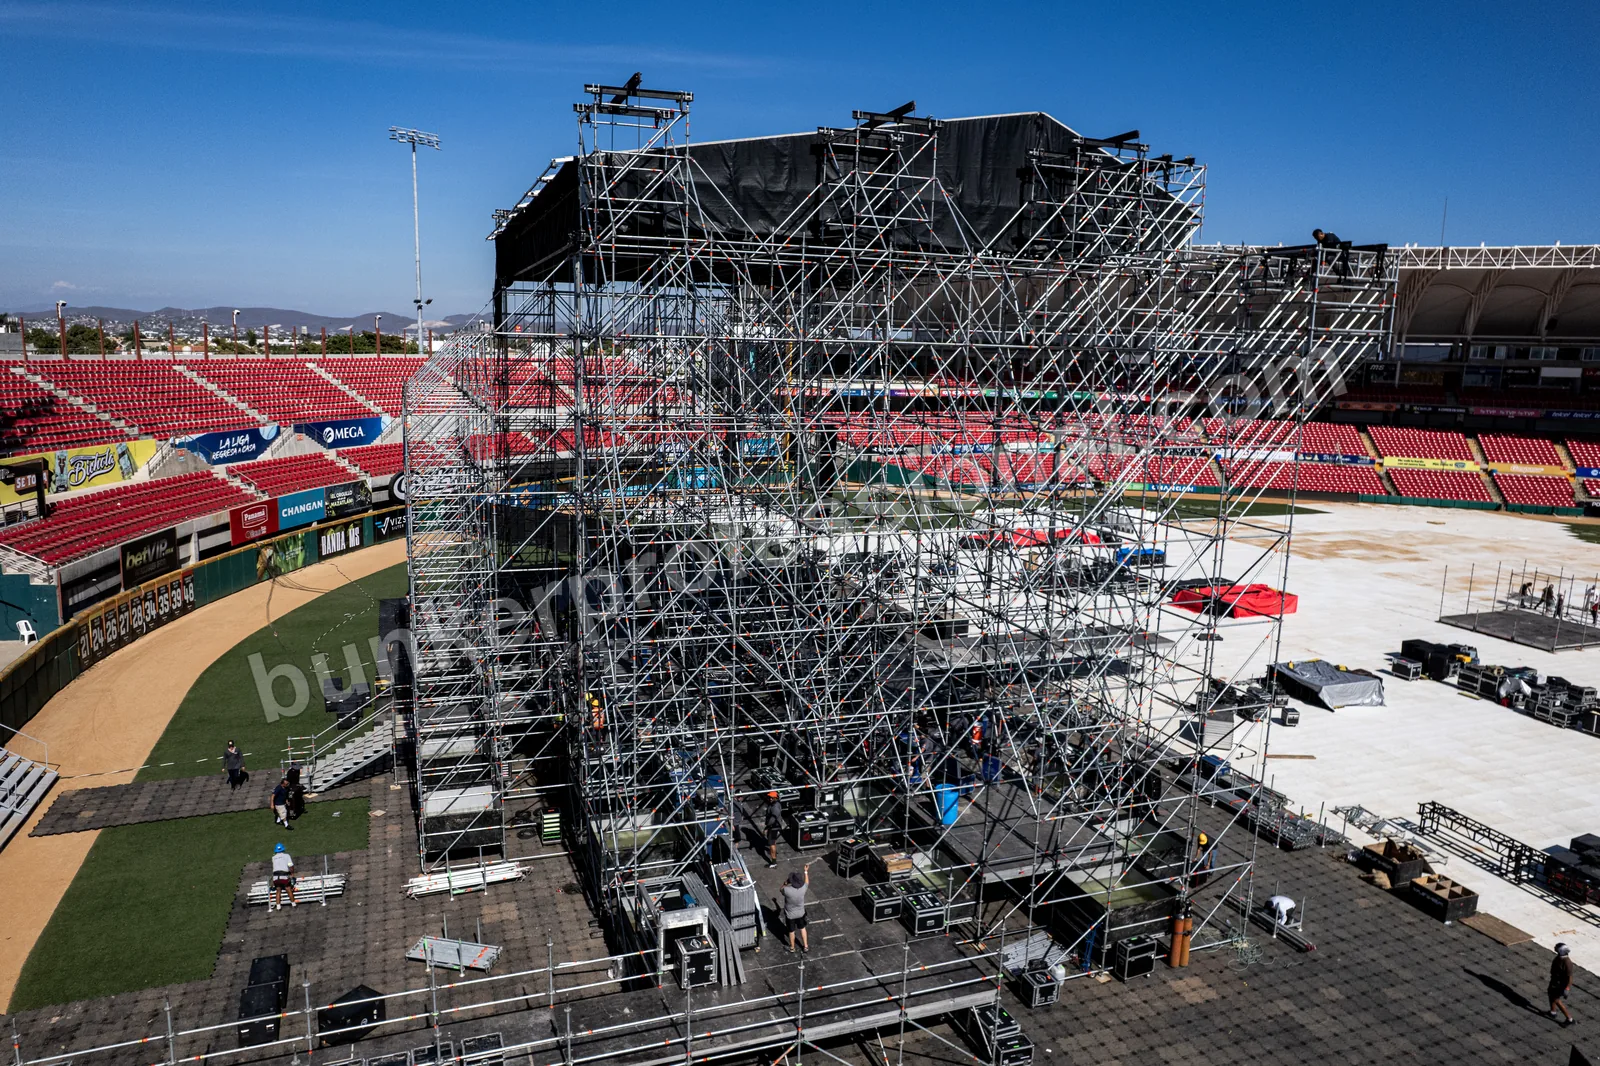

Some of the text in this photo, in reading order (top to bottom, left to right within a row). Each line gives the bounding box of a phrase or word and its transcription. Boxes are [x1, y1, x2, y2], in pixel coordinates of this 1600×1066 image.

[219, 433, 250, 448] LA LIGA
[335, 426, 364, 440] MEGA
[281, 499, 323, 518] CHANGAN
[321, 530, 346, 556] BANDA
[349, 526, 361, 548] MS
[158, 593, 170, 615] 35
[171, 588, 182, 610] 39
[183, 582, 195, 604] 48
[132, 604, 144, 629] 28
[145, 599, 157, 623] 34
[106, 618, 118, 643] 26
[119, 611, 130, 636] 27
[80, 634, 90, 659] 21
[92, 626, 104, 652] 24
